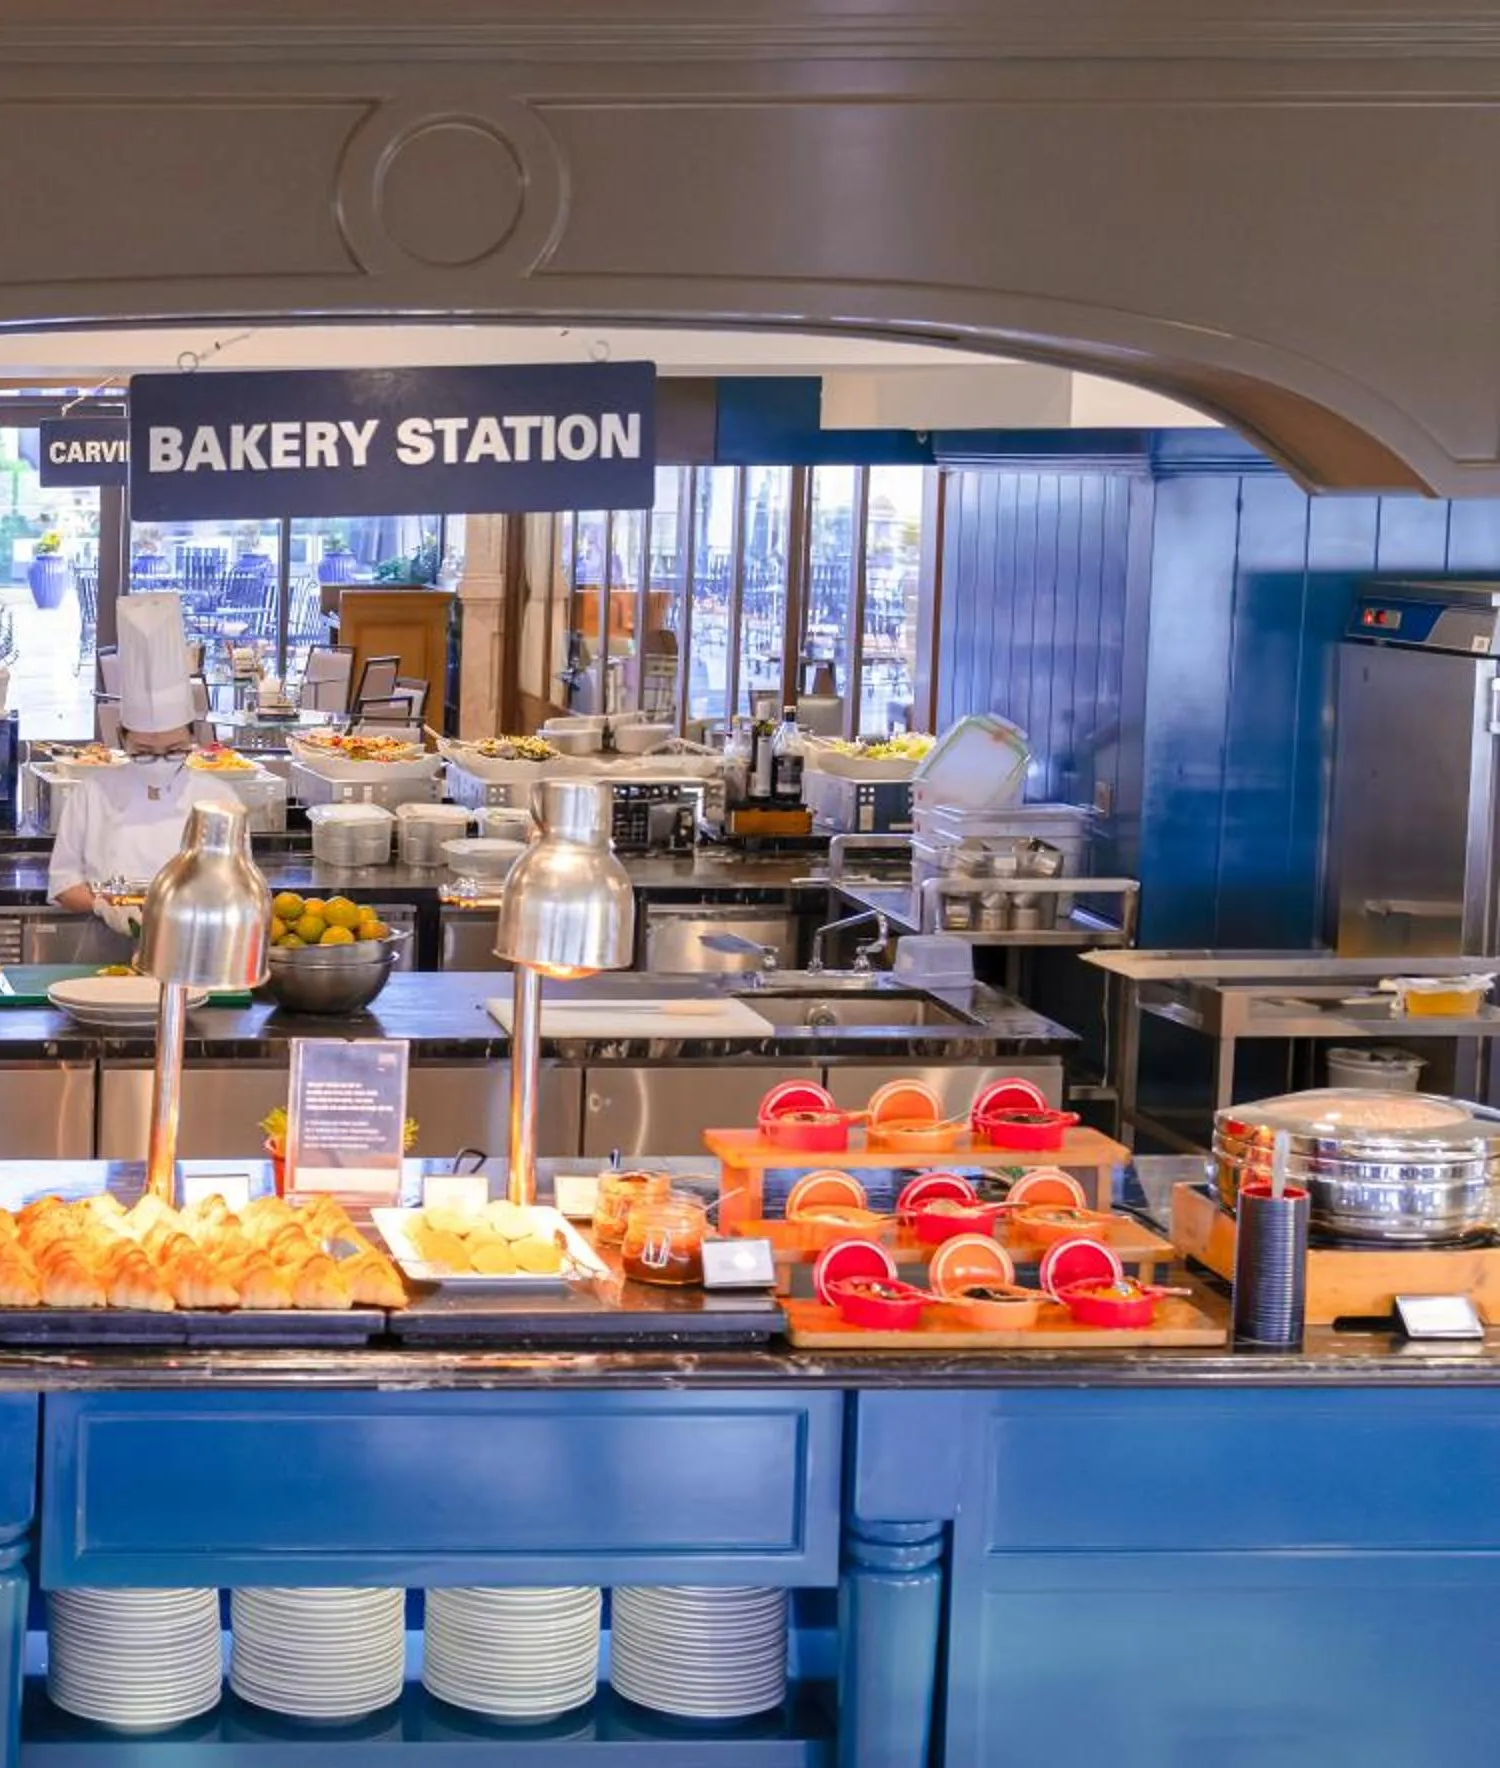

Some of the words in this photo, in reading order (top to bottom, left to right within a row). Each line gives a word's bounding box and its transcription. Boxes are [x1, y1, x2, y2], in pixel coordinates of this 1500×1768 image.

[49, 441, 130, 464] CARVI
[149, 419, 380, 472] BAKERY
[396, 413, 640, 465] STATION
